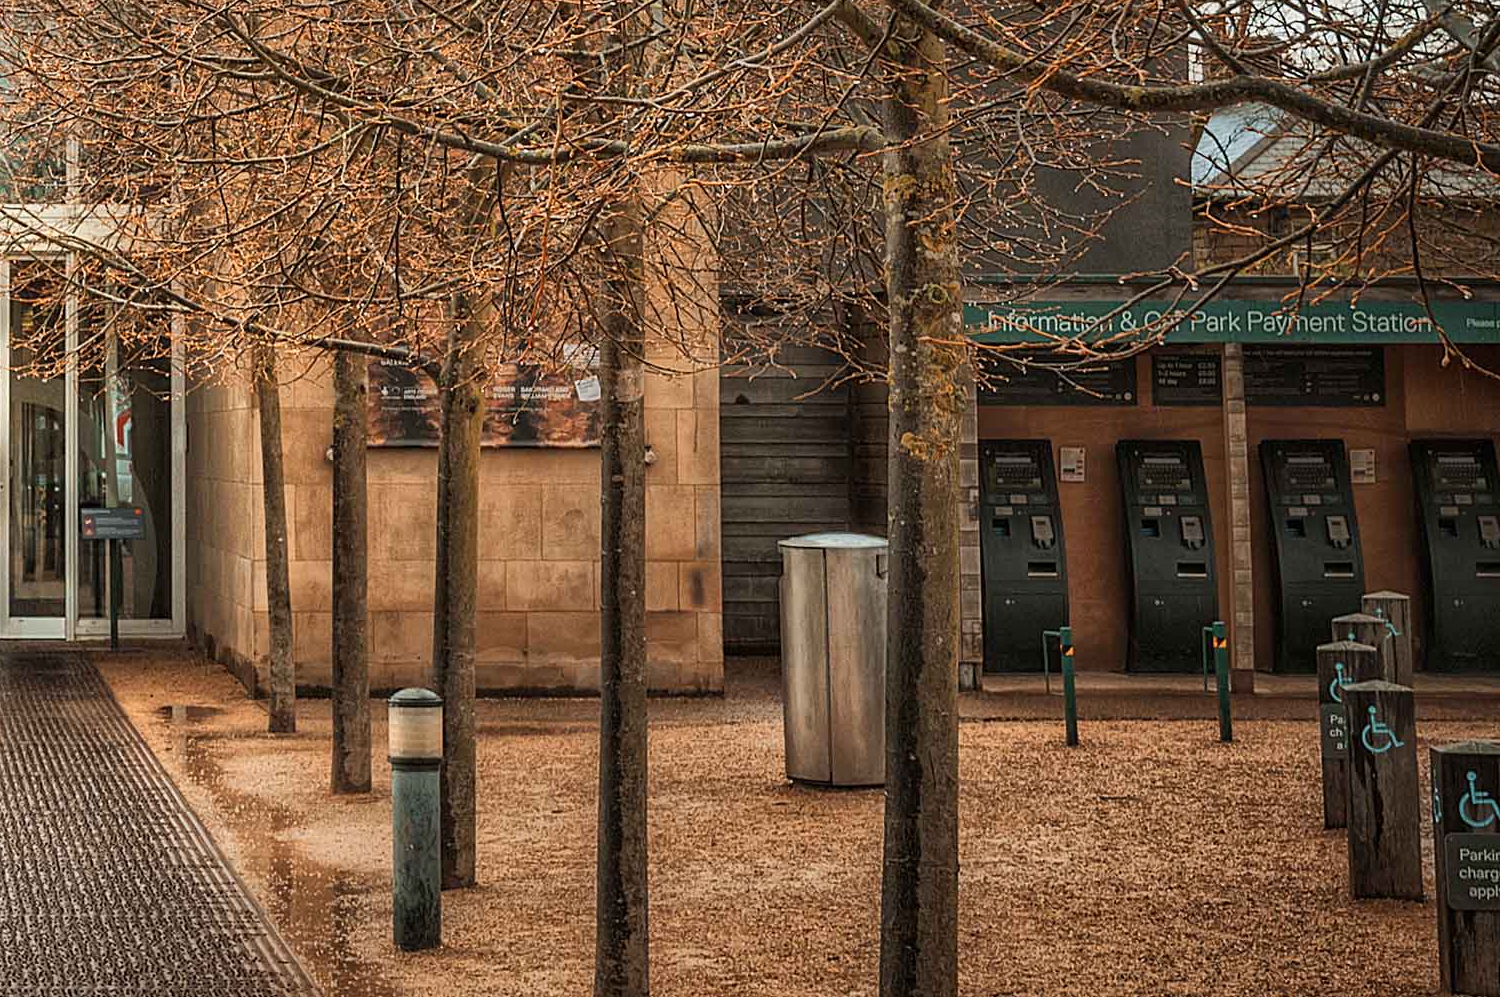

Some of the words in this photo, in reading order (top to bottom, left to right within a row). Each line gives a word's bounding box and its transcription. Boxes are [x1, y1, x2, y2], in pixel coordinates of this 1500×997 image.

[1120, 310, 1137, 332] &
[1190, 310, 1240, 332] Park
[1247, 310, 1346, 336] Payment
[1352, 310, 1431, 332] Station
[1466, 318, 1495, 328] Please
[1459, 865, 1500, 883] charg
[1469, 884, 1500, 901] appl
